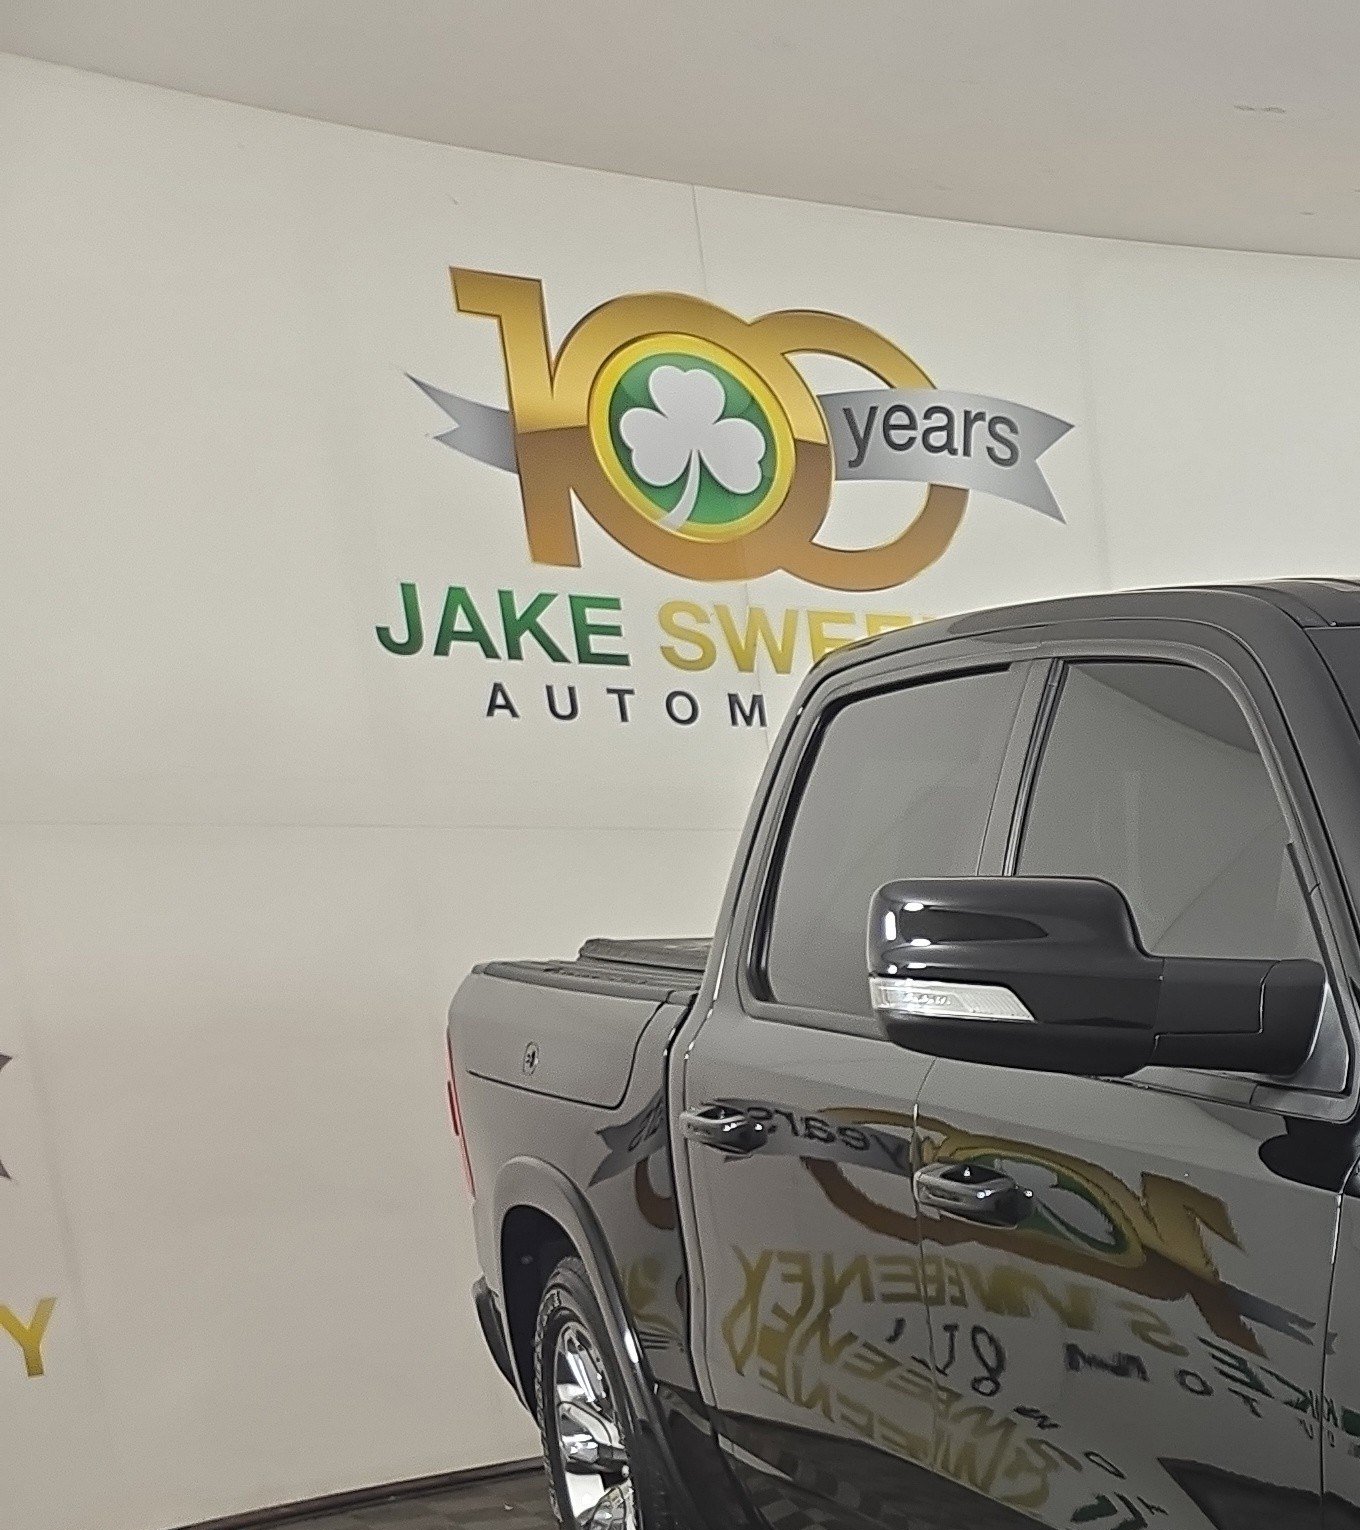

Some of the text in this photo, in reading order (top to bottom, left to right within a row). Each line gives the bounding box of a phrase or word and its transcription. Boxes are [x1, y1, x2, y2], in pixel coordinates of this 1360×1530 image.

[842, 399, 1021, 468] years
[375, 581, 631, 667] JAKE
[485, 682, 768, 728] AUTOM
